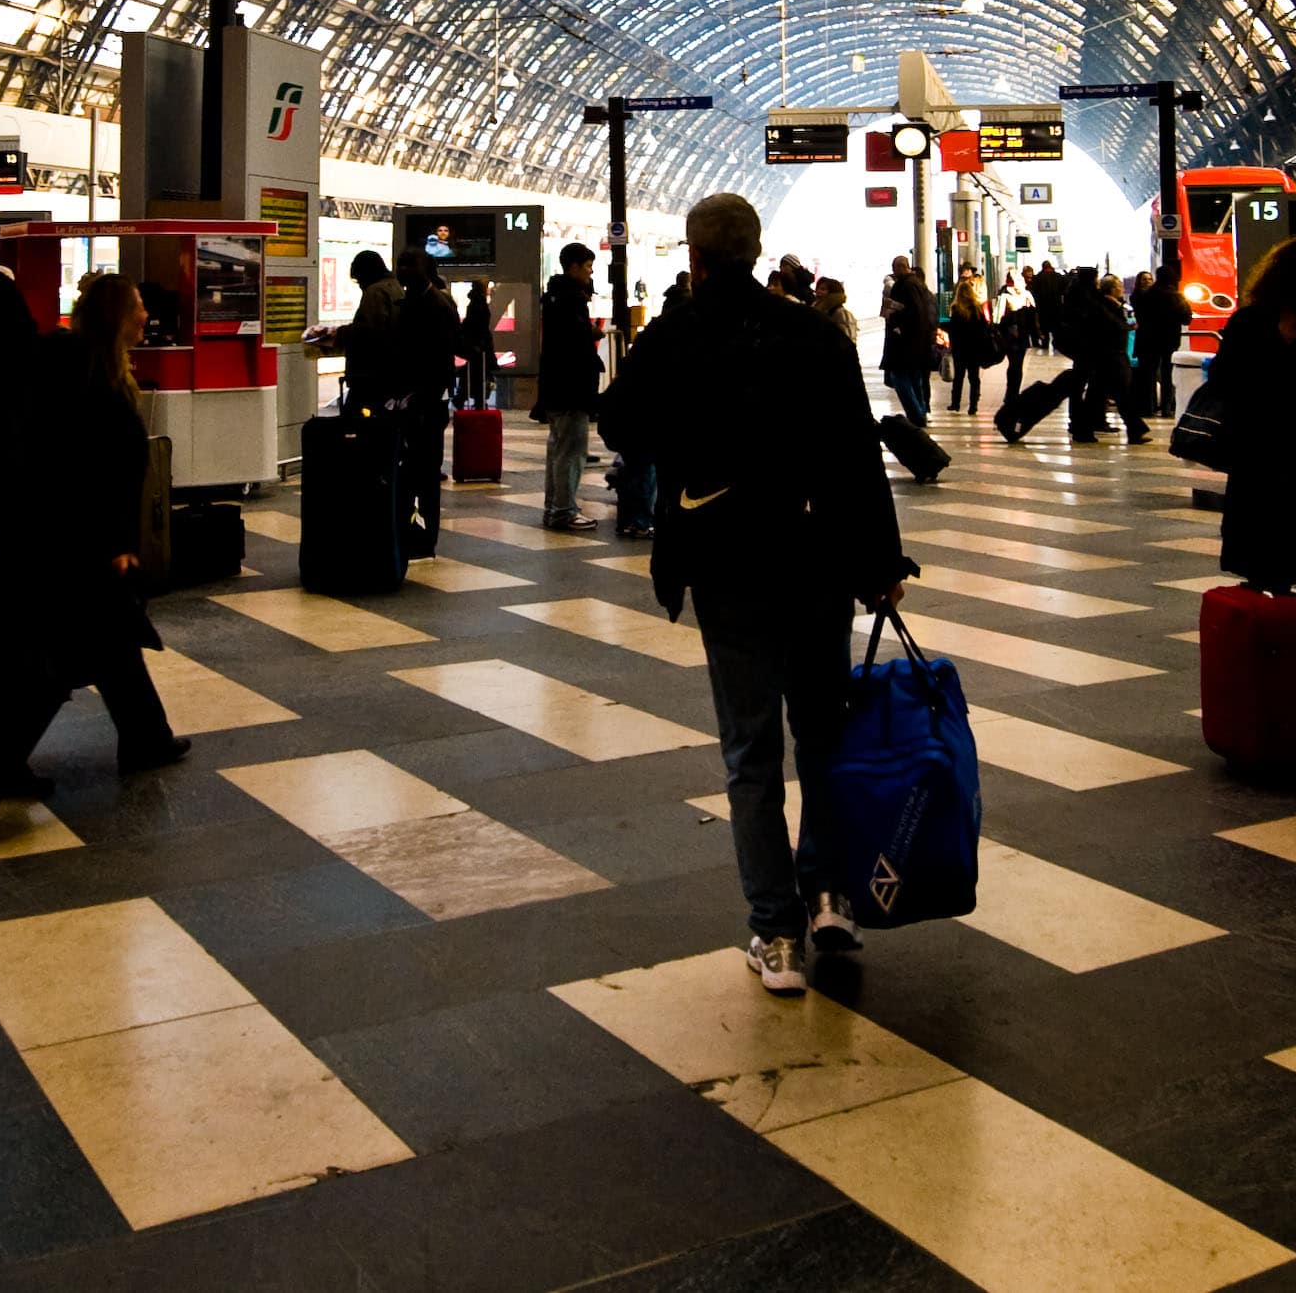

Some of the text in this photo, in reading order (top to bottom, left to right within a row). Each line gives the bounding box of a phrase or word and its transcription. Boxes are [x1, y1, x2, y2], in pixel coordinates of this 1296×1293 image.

[628, 99, 659, 107] Smoking
[767, 129, 780, 140] 14
[1048, 125, 1063, 136] 15
[1031, 188, 1040, 199] A
[1248, 200, 1280, 222] 15
[503, 212, 529, 231] 14
